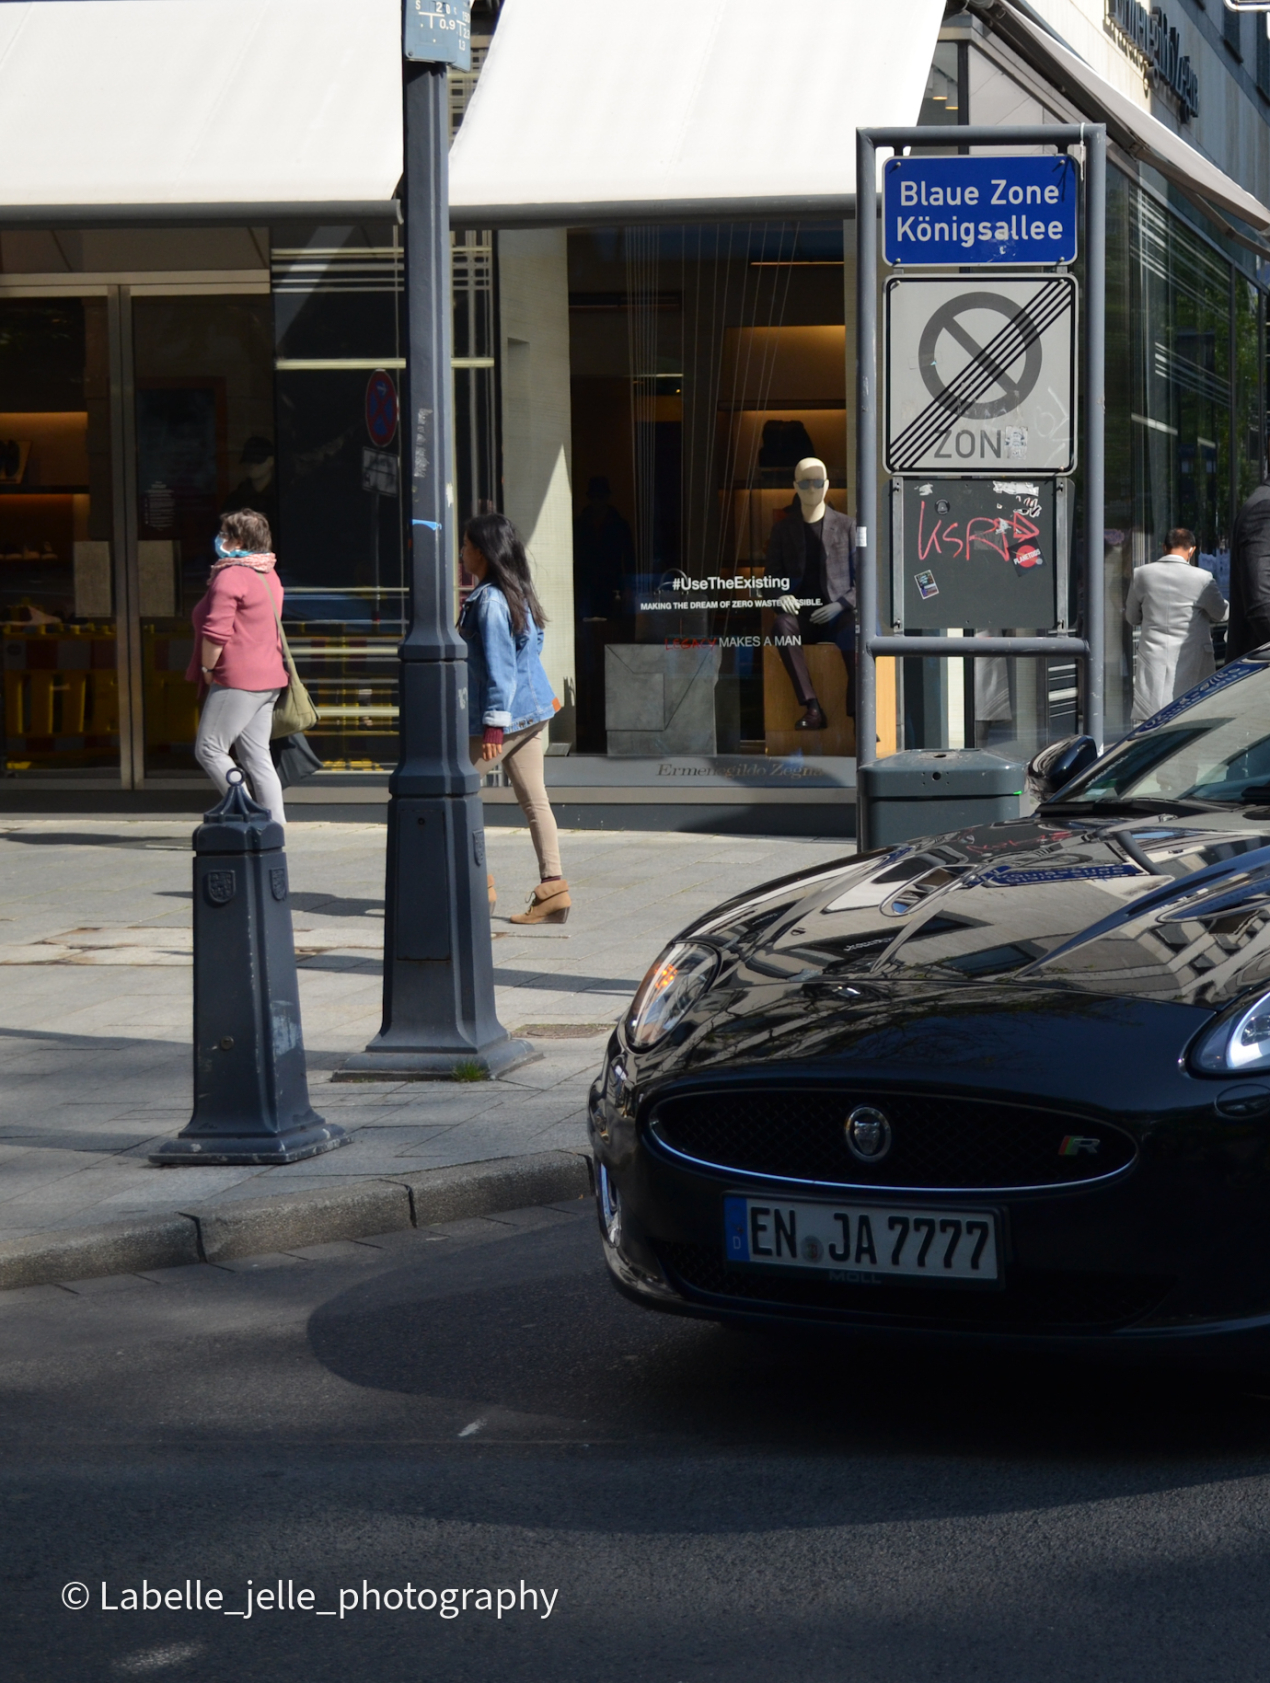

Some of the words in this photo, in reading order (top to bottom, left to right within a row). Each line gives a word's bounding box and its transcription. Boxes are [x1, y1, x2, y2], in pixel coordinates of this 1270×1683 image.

[439, 18, 456, 30] 0.9
[900, 180, 980, 206] Blaue
[990, 179, 1060, 205] Zone
[896, 214, 1064, 248] Königsallee
[933, 429, 1010, 459] ZON
[672, 575, 791, 591] #UseTheExisting
[640, 601, 672, 611] MAKING
[673, 601, 688, 610] THE
[690, 601, 718, 610] DREAM
[719, 600, 731, 609] OF
[732, 600, 752, 609] ZERO
[665, 637, 717, 650] LEGACY
[718, 636, 761, 648] MAKES
[763, 637, 772, 646] A
[774, 635, 802, 646] MAN
[656, 762, 767, 779] Ermenegildo
[769, 762, 824, 779] Zegna
[732, 1235, 742, 1251] D
[750, 1206, 798, 1259] EN
[828, 1212, 878, 1265] JA
[887, 1216, 990, 1271] 7777
[829, 1270, 882, 1285] MOLL
